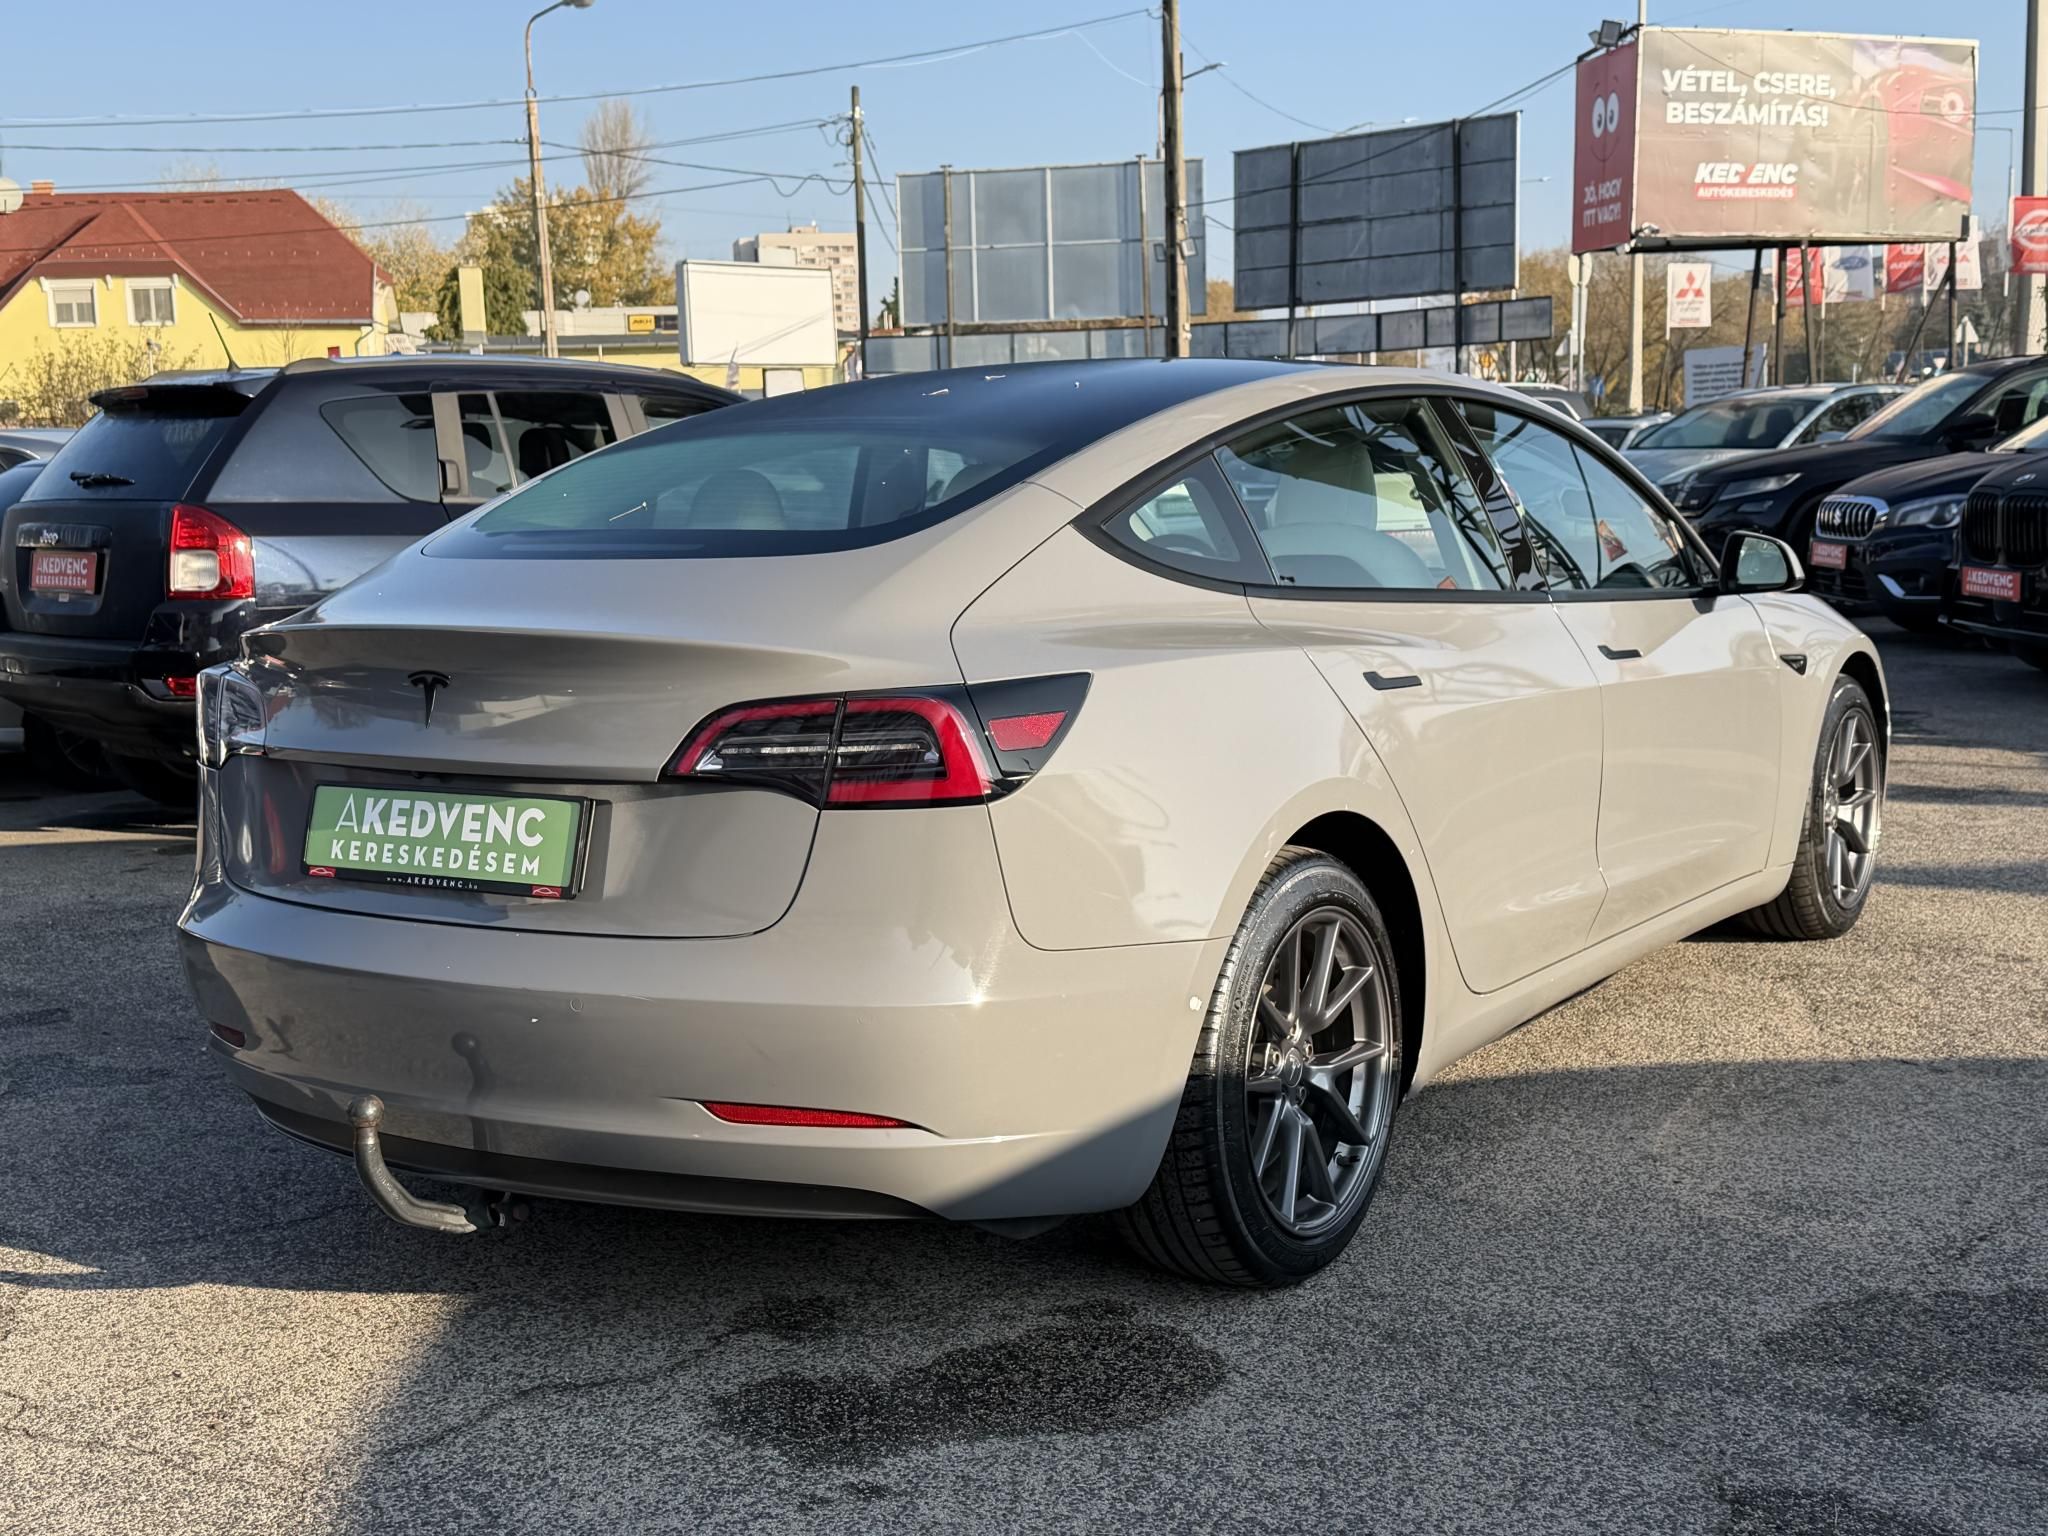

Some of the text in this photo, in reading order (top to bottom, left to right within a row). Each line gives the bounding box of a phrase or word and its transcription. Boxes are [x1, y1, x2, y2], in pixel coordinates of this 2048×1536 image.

[1662, 64, 1836, 99] VÉTEL, CSERE,
[1666, 99, 1829, 127] BESZÁMÍTÁS!
[1697, 185, 1794, 198] AUTÓKERESKEDÉS
[37, 557, 88, 575] AKEDVENC
[1968, 570, 2014, 588] AKEDVENC
[335, 793, 547, 848] AKEDVENC
[330, 838, 541, 877] KERESKEDÉSEM
